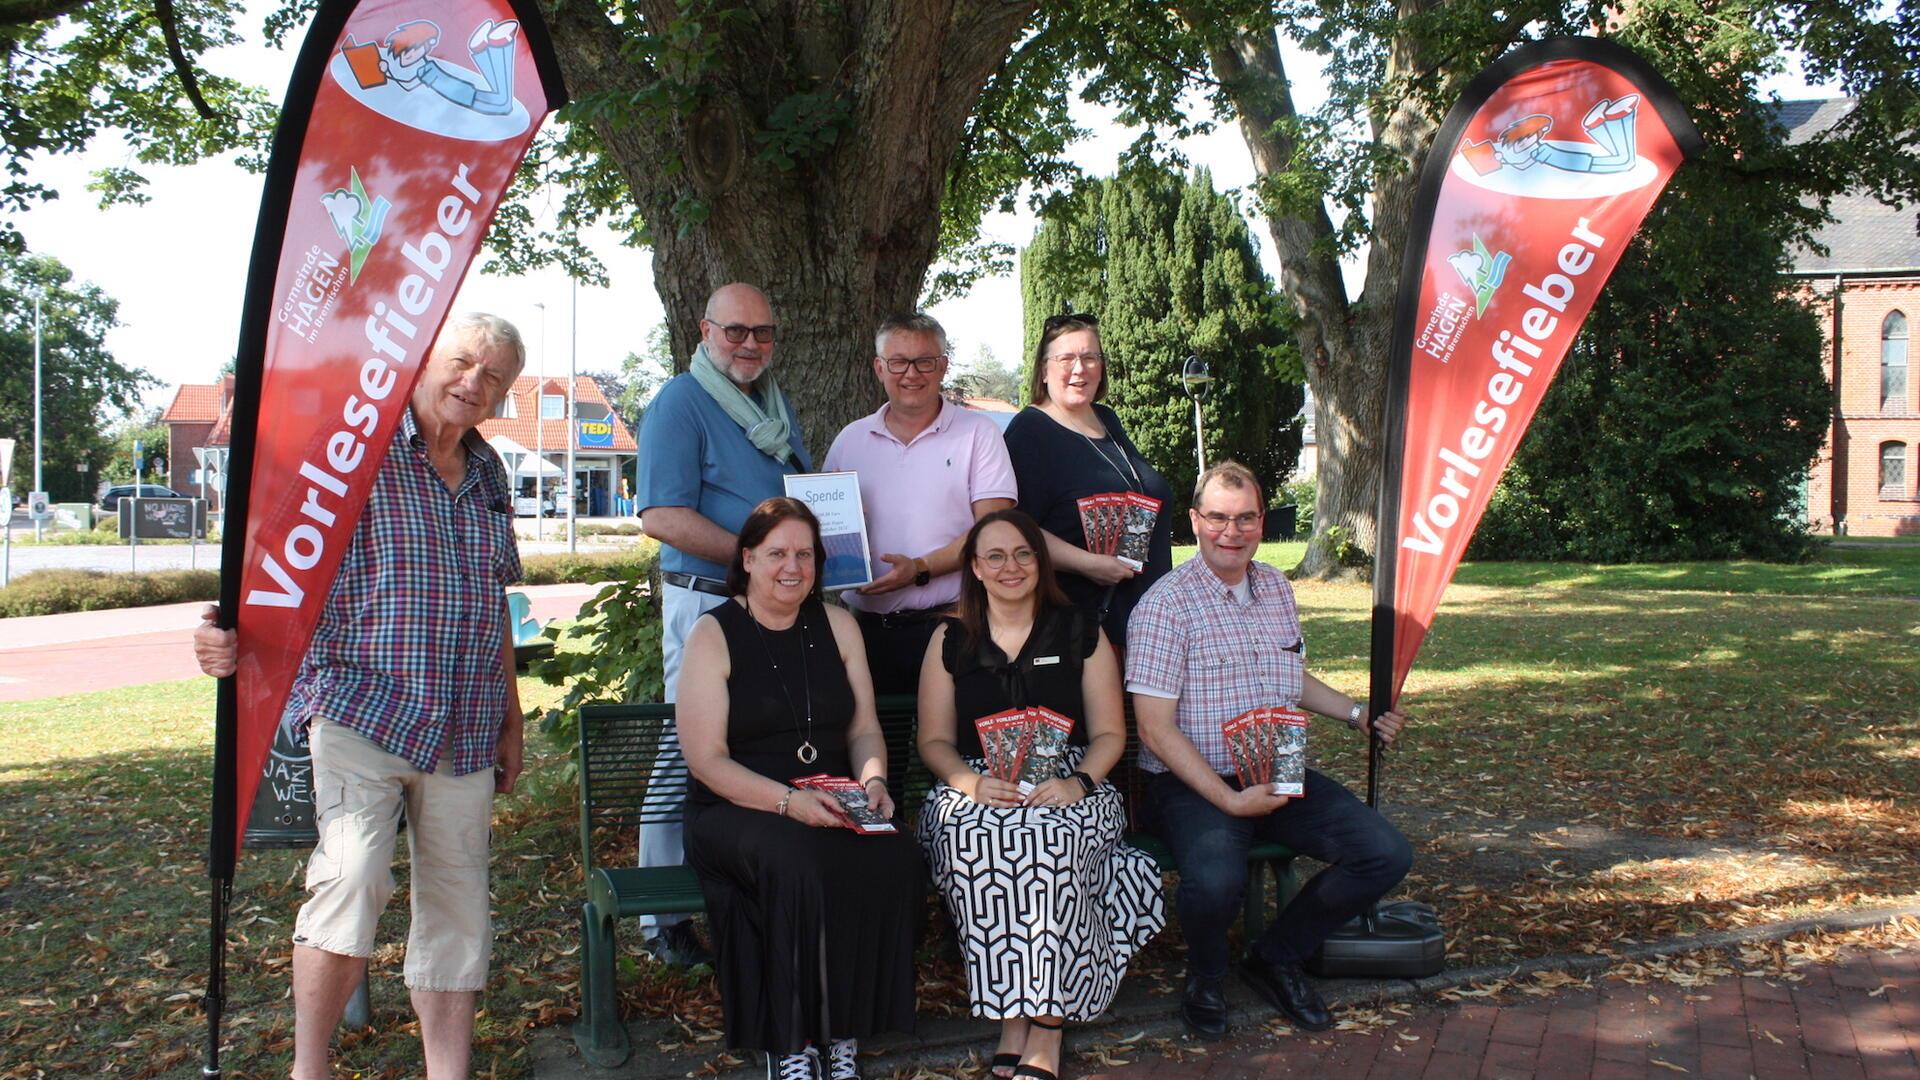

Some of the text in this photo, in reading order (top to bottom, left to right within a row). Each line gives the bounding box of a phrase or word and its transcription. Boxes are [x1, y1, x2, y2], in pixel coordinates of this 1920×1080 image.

[278, 244, 321, 323] Gemeinde
[287, 251, 340, 338] HAGEN
[306, 266, 349, 345] im Bremischen
[1416, 291, 1450, 349] Gemeinde
[1425, 296, 1467, 359] HAGEN
[1441, 305, 1476, 364] im Bremischen
[245, 162, 482, 609] Vorlesefieber
[1401, 216, 1606, 556] Vorlesefieber
[805, 488, 845, 506] Spende
